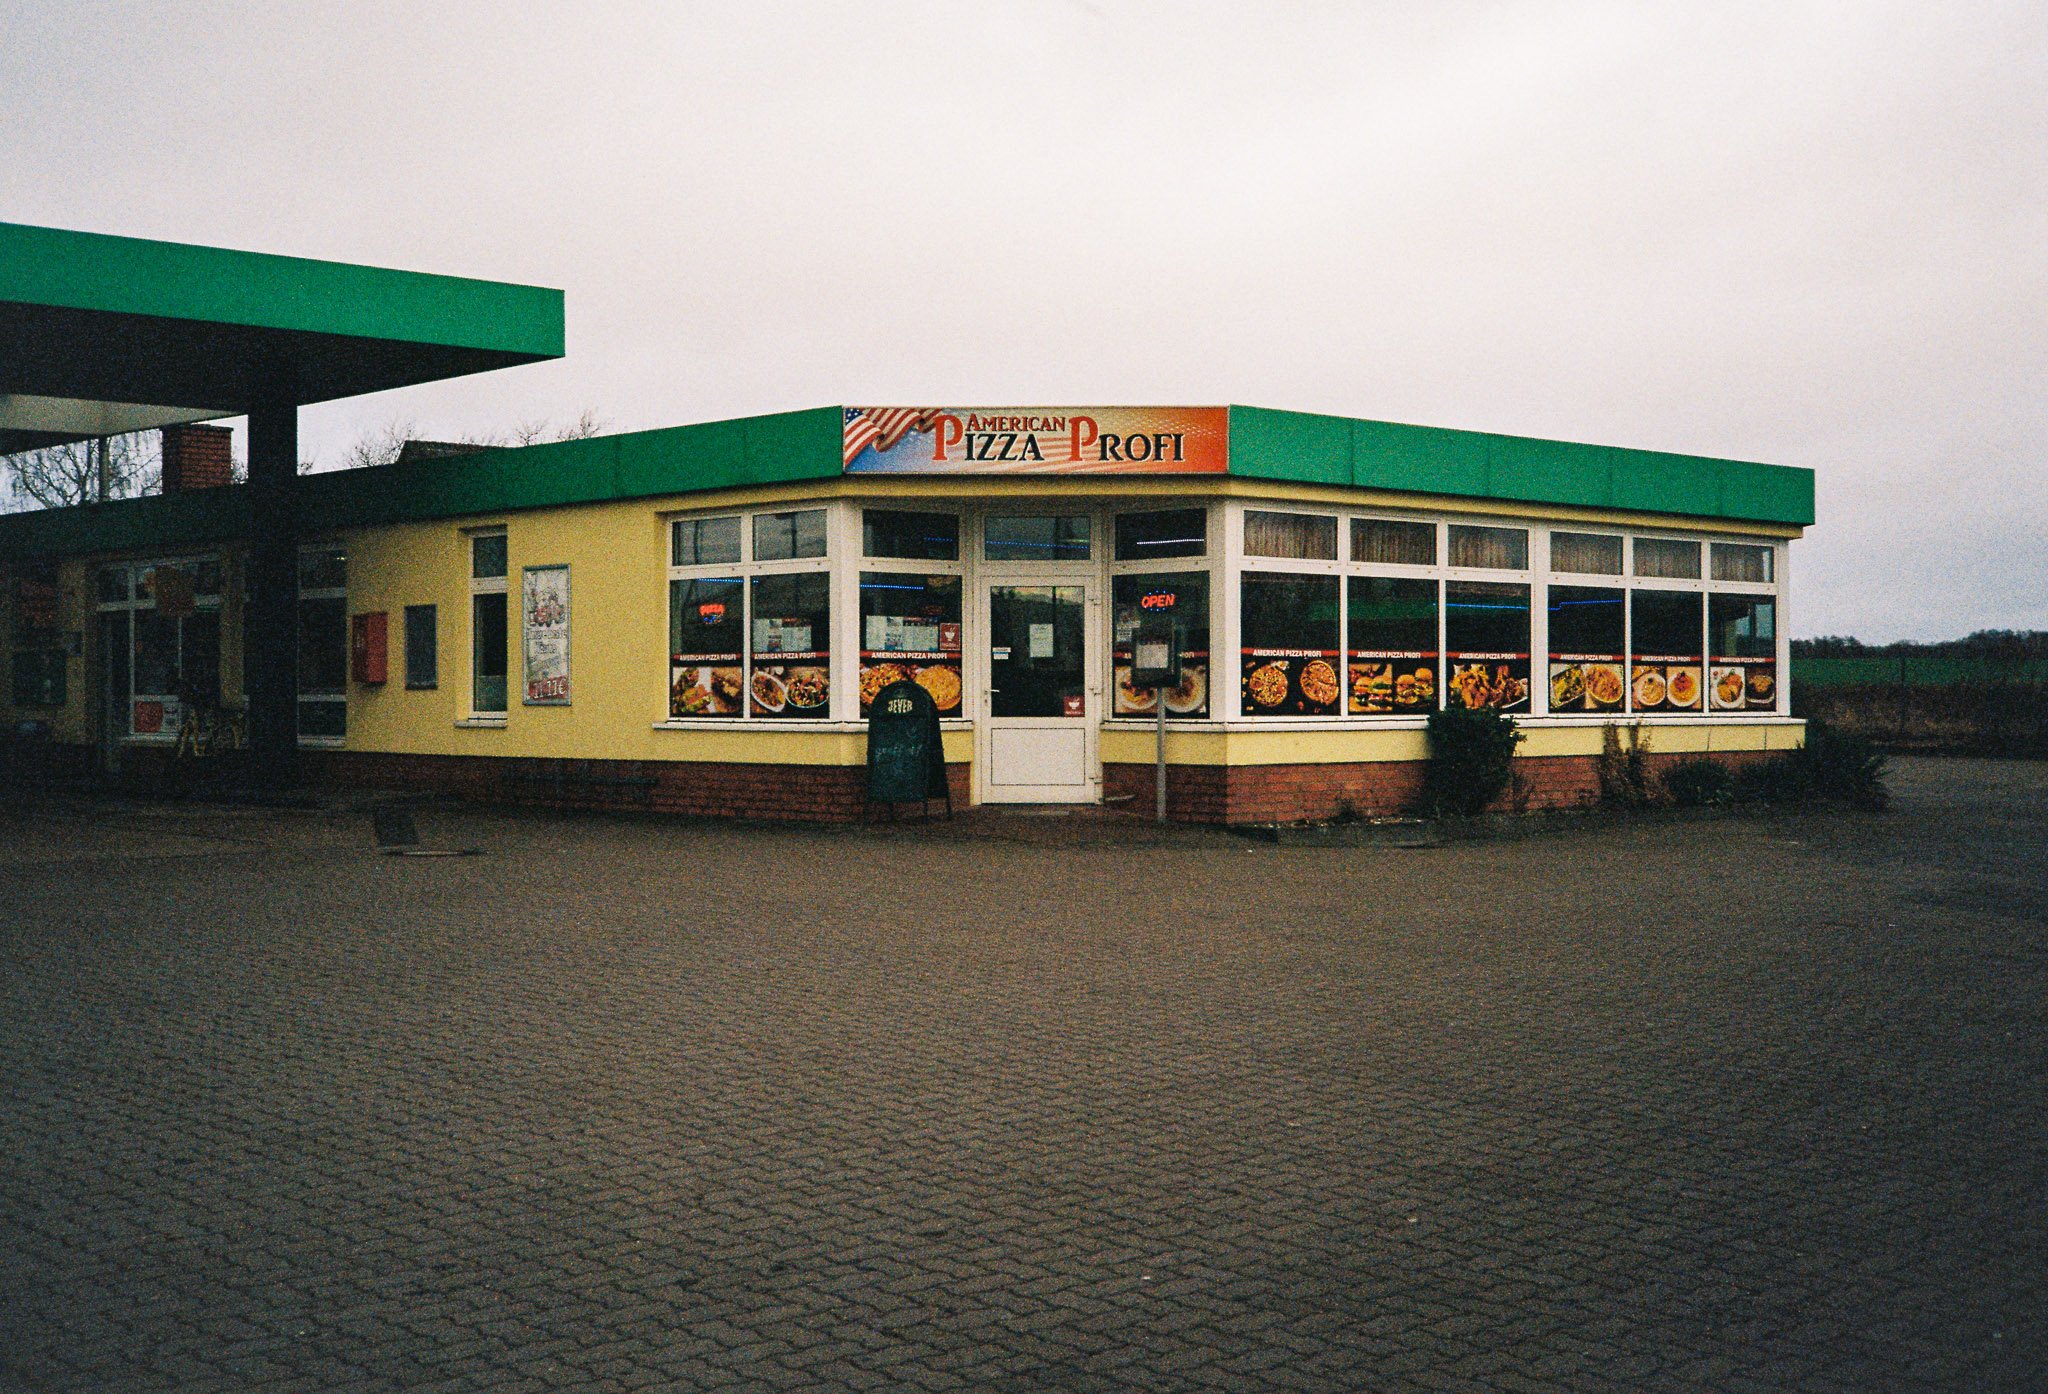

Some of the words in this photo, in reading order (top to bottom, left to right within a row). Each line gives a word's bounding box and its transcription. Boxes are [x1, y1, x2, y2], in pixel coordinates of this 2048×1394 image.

[965, 413, 1066, 432] AMERICAN
[932, 415, 1043, 461] PIZZA
[1069, 415, 1185, 461] PROFI
[1141, 594, 1175, 608] OPEN
[721, 653, 736, 661] PROFI
[782, 652, 798, 660] PIZZA
[927, 652, 947, 660] PROFI
[1252, 649, 1285, 657] AMERICAN
[1303, 650, 1321, 658] PROFI
[887, 698, 913, 714] JEVER
